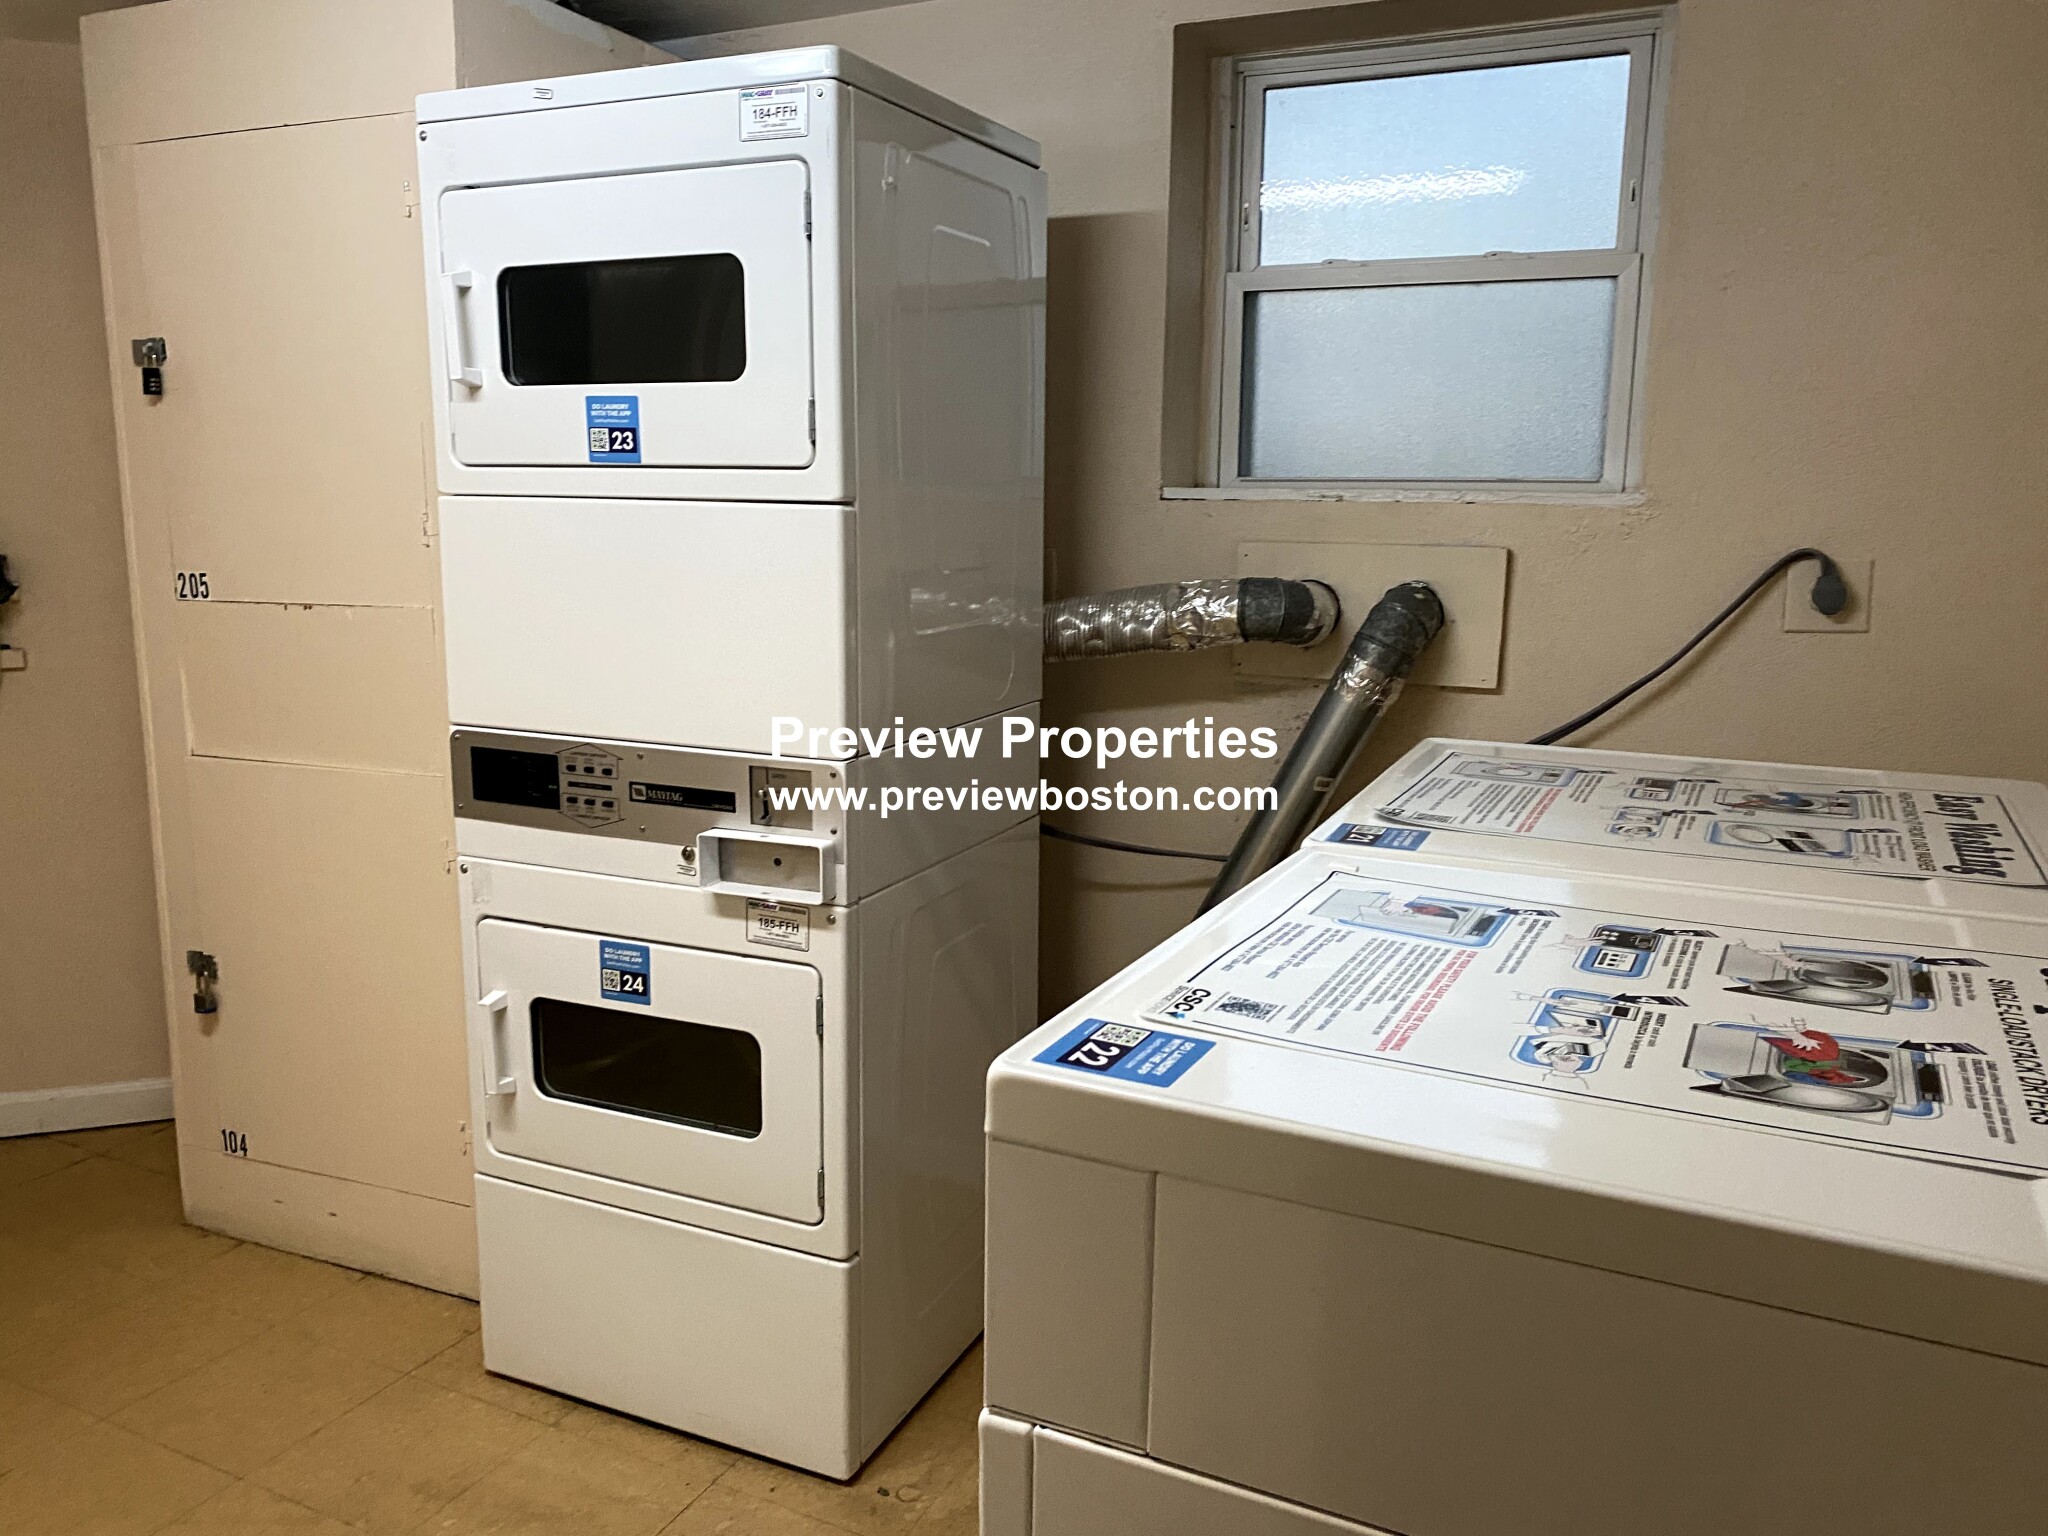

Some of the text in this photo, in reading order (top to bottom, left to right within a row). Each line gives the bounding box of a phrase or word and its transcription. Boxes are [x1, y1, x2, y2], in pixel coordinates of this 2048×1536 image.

[752, 105, 798, 119] 184-FFH
[611, 431, 634, 450] 23
[177, 572, 209, 599] 205
[647, 789, 683, 802] MAYTAG
[1346, 833, 1375, 843] 21
[1924, 793, 2015, 879] Easy Washing
[758, 917, 799, 933] 185-FFH
[622, 974, 644, 993] 24
[1174, 988, 1211, 1012] CSC
[1066, 1041, 1120, 1067] 22
[1988, 978, 2046, 1077] SINGLE-LOAD/STACK
[2017, 1075, 2048, 1126] DRYERS
[1134, 1062, 1156, 1074] APP
[221, 1129, 248, 1157] 104
